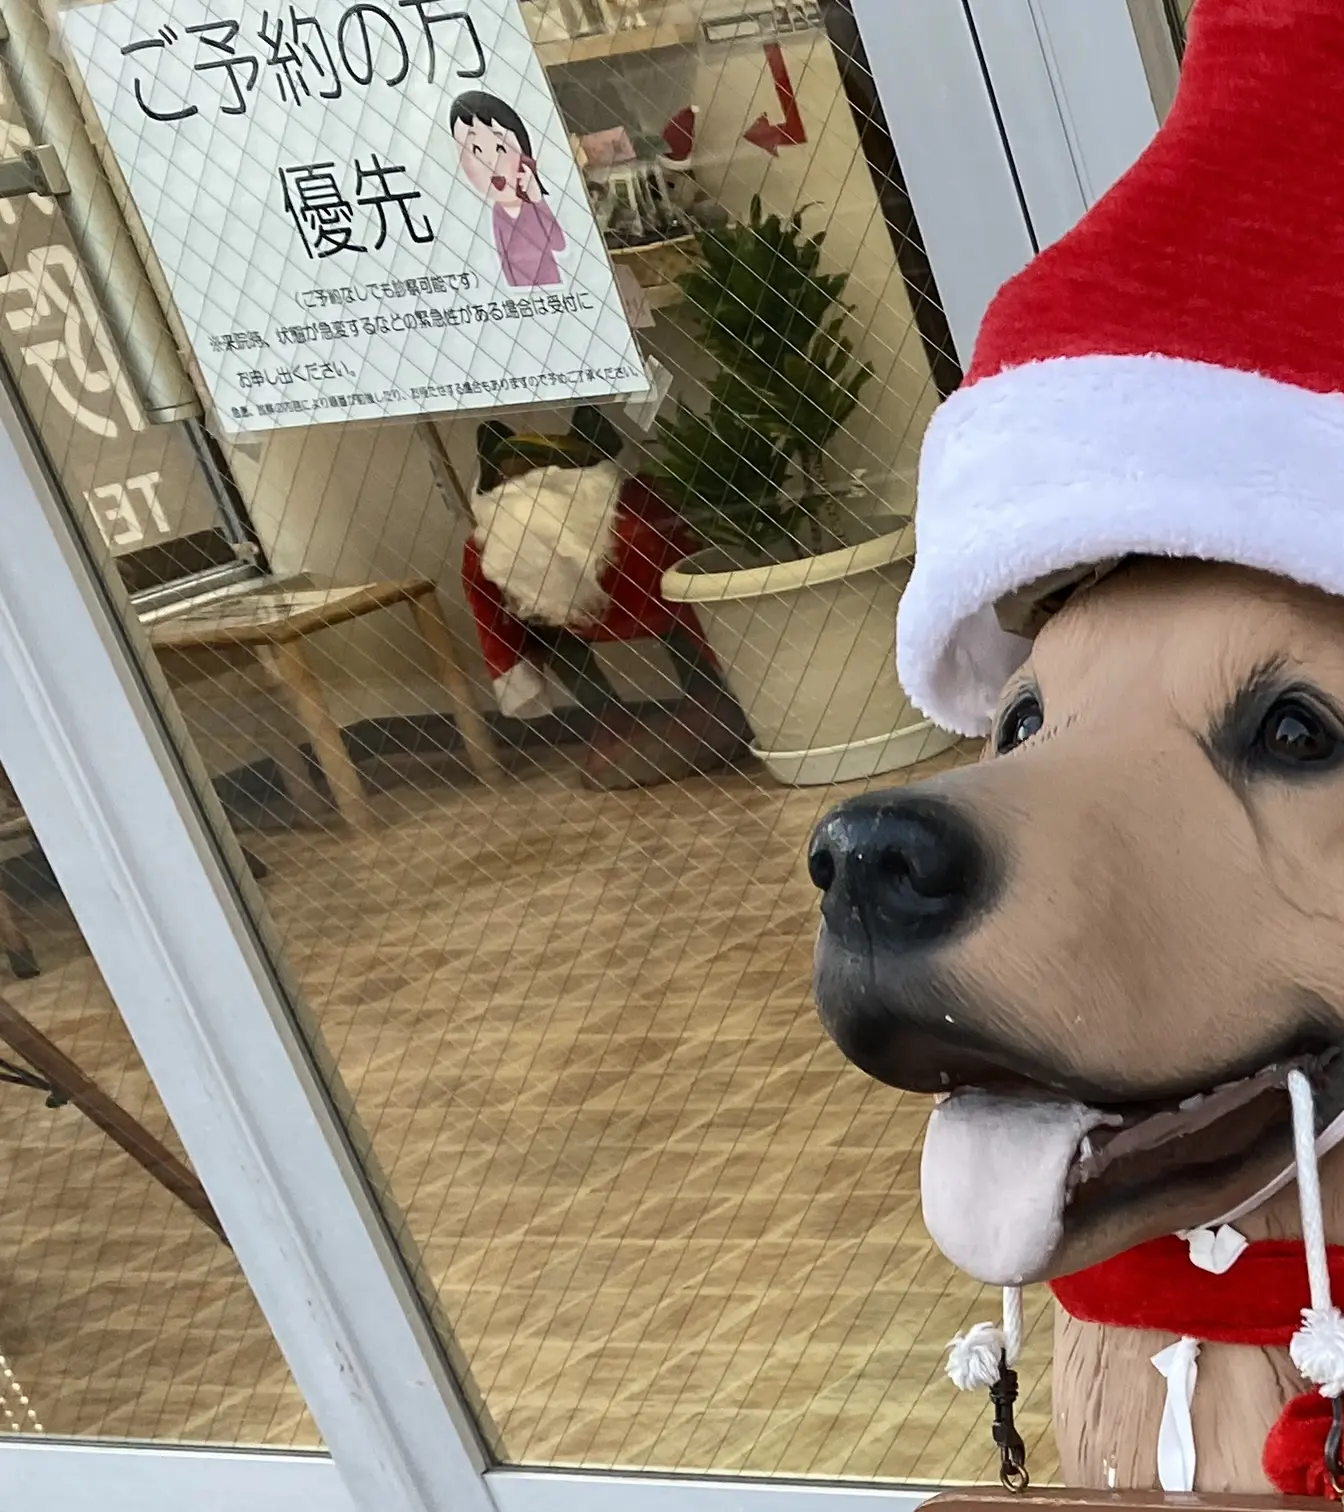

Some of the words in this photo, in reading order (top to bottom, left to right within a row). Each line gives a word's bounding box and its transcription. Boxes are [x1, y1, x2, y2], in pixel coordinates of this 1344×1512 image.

[119, 0, 487, 122] ご予約の方
[278, 153, 436, 260] 優先
[236, 360, 358, 389] お申し出ください。
